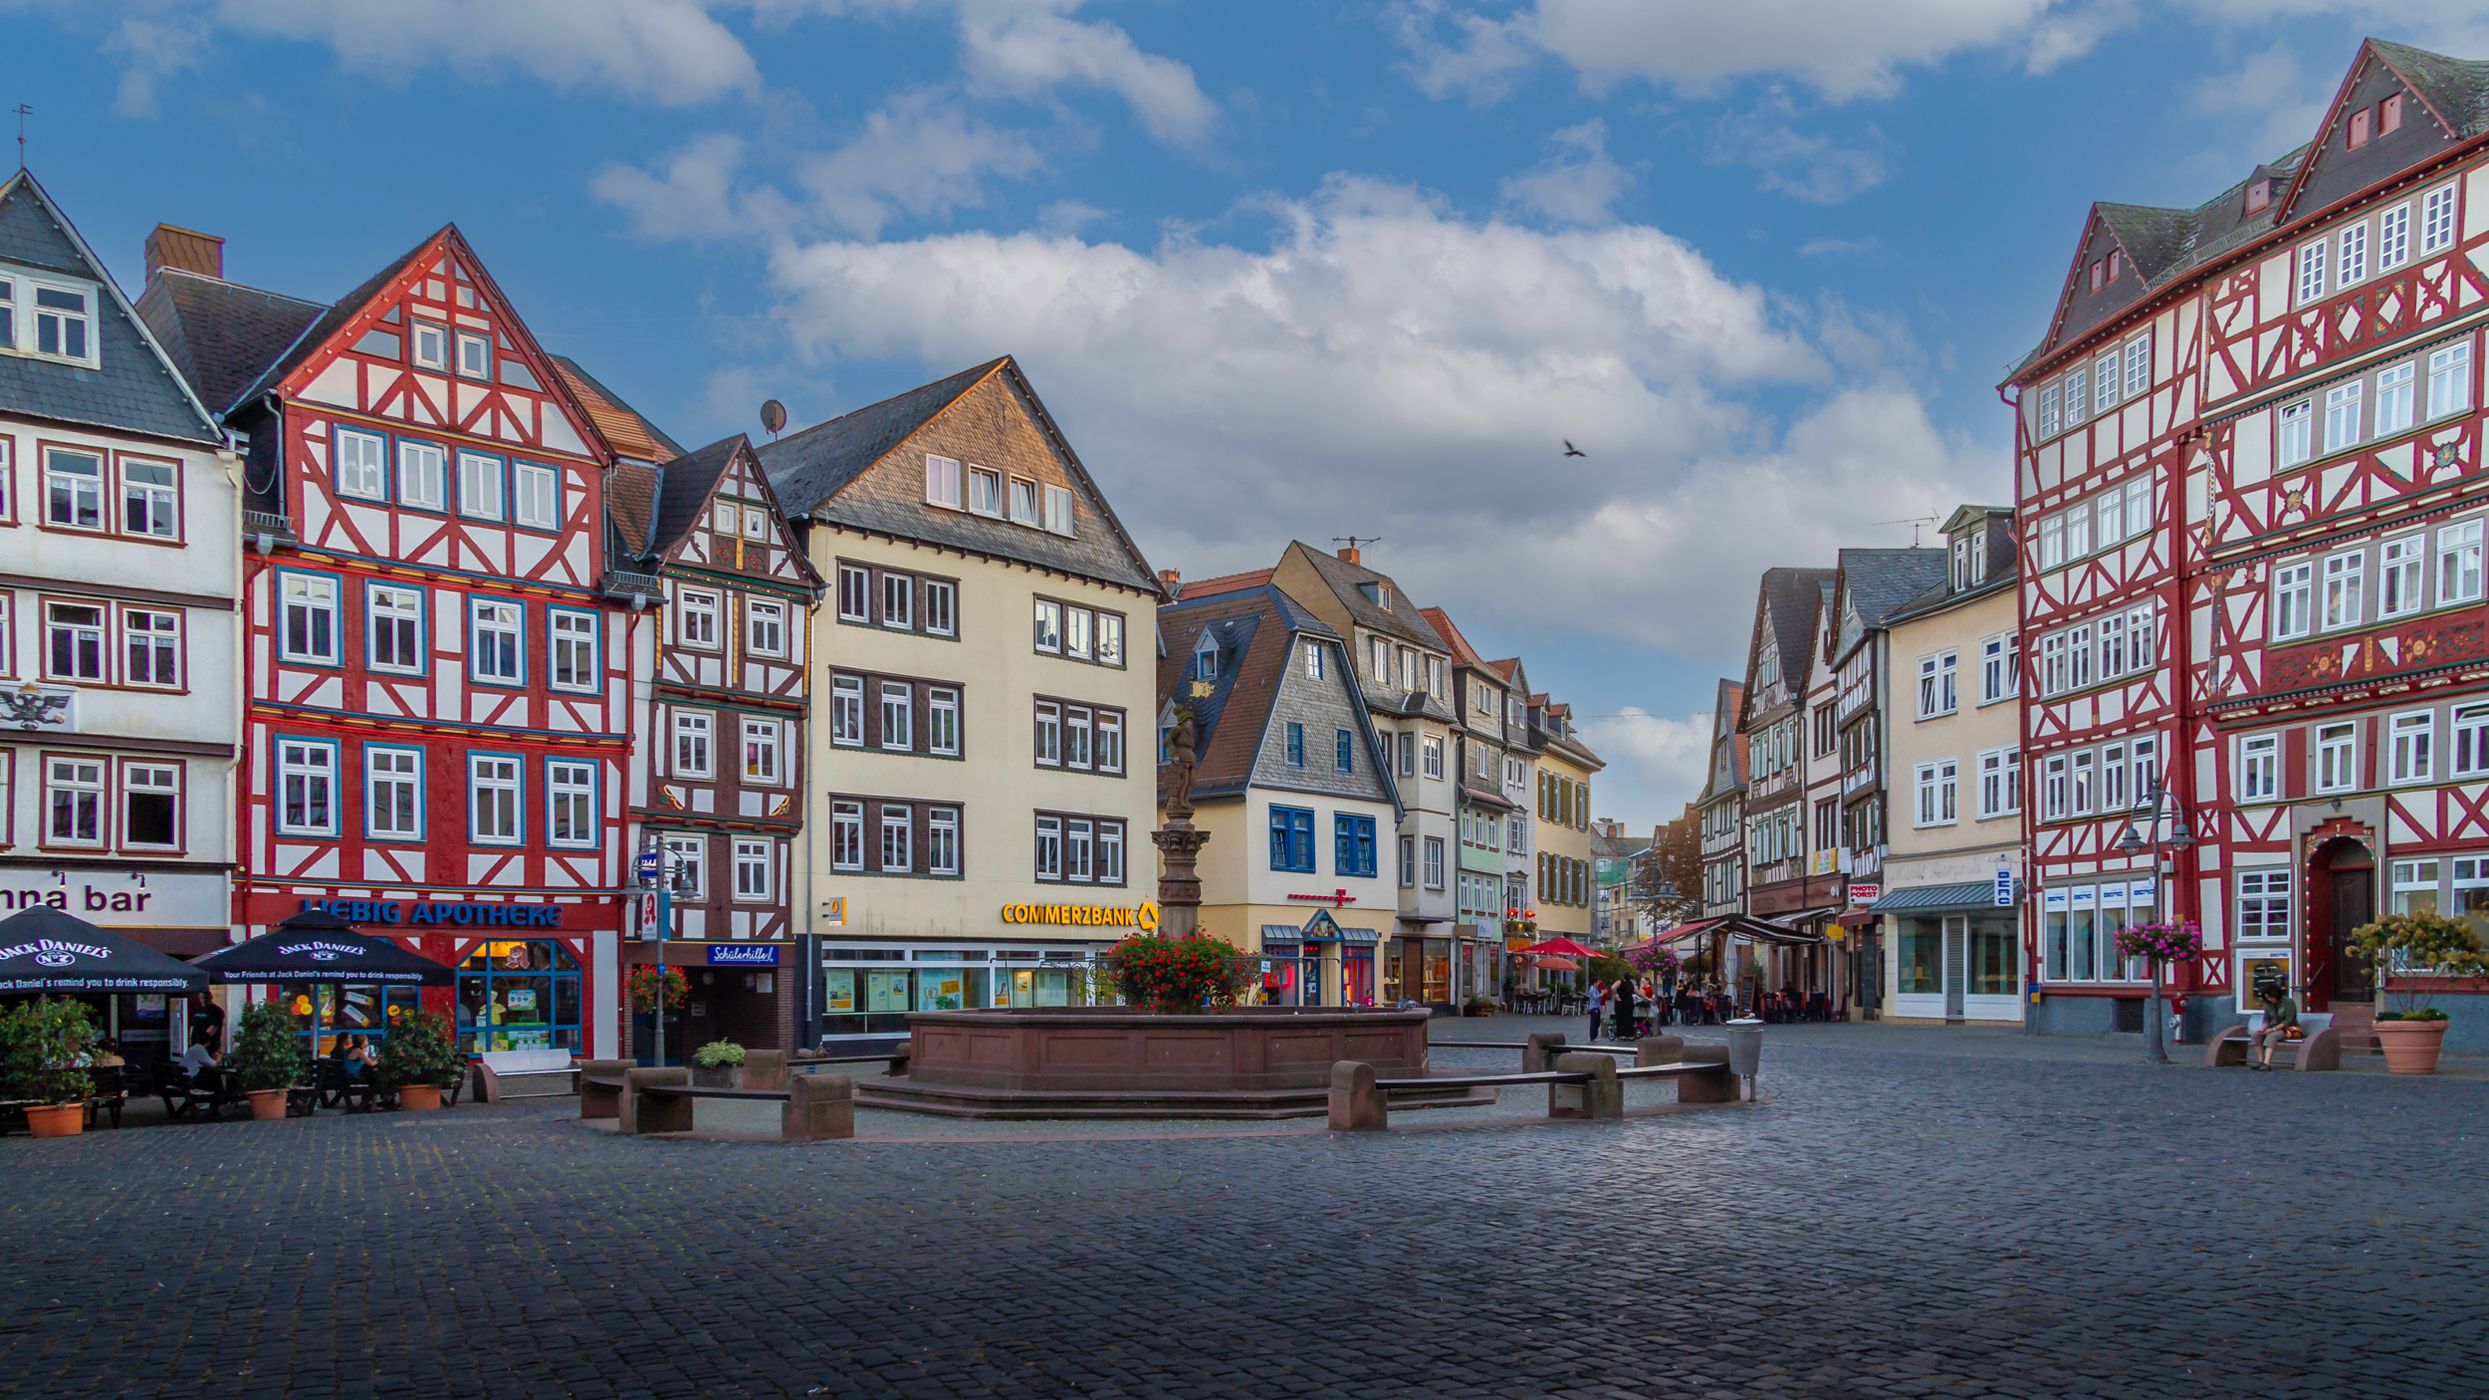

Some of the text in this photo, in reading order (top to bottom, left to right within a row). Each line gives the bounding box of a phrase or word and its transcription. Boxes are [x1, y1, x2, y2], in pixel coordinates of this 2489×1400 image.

[85, 885, 151, 912] bar
[411, 902, 563, 926] APOTHEKE
[1002, 903, 1135, 926] COMMERZBANK
[0, 938, 112, 960] JACK DANIEL'S
[277, 941, 367, 956] JACK DANIEL'S
[713, 946, 774, 963] Schülerhilfe!
[53, 978, 85, 987] remind
[86, 979, 103, 989] you
[104, 978, 114, 987] to
[115, 978, 138, 987] drink
[139, 978, 190, 989] responsibly.
[223, 971, 241, 979] Your
[241, 971, 268, 979] Friends
[345, 972, 359, 980] you
[367, 971, 385, 979] drink
[385, 972, 424, 981] responsibly.
